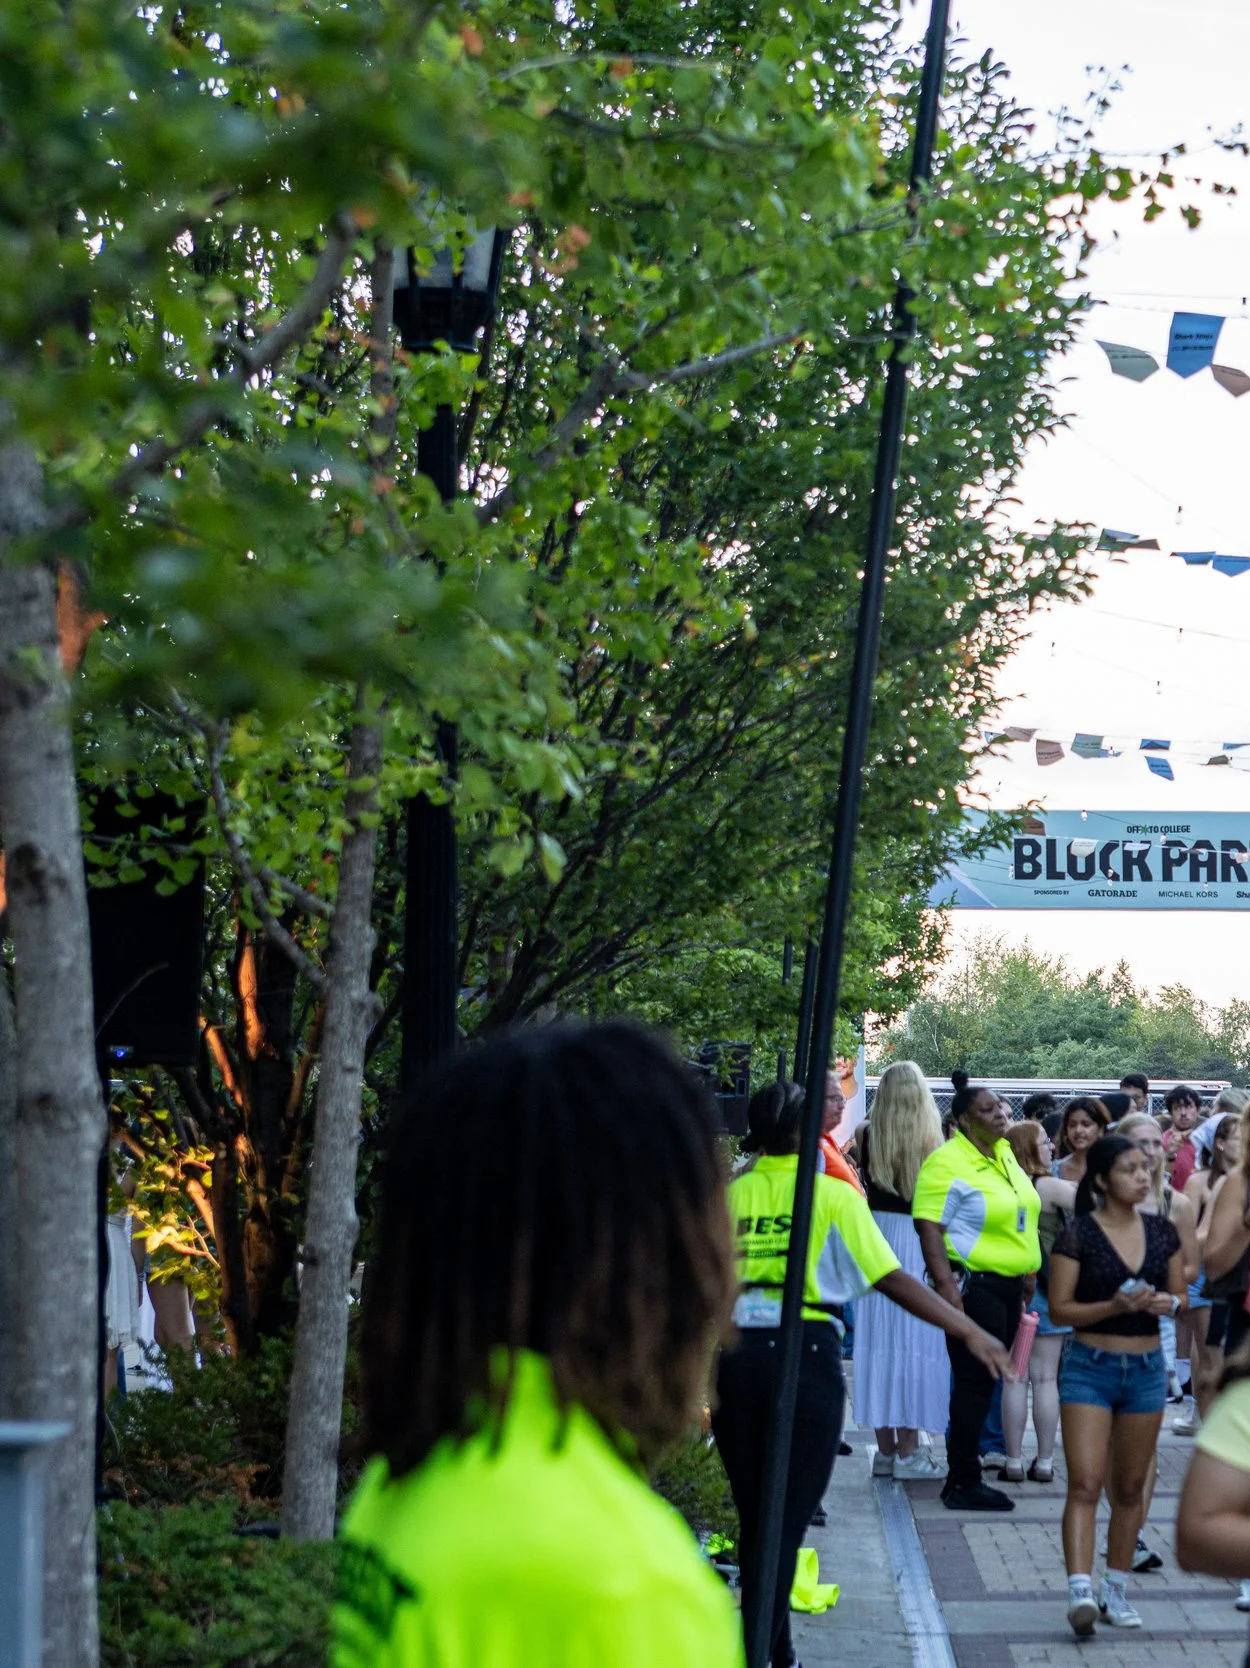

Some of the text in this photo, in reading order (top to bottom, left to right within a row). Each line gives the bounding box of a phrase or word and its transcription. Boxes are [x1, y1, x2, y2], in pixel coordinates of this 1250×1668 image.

[1126, 825, 1191, 834] OFF TO COLLEGE
[1014, 838, 1153, 882] BLOCK
[1088, 889, 1138, 898] GATORADE
